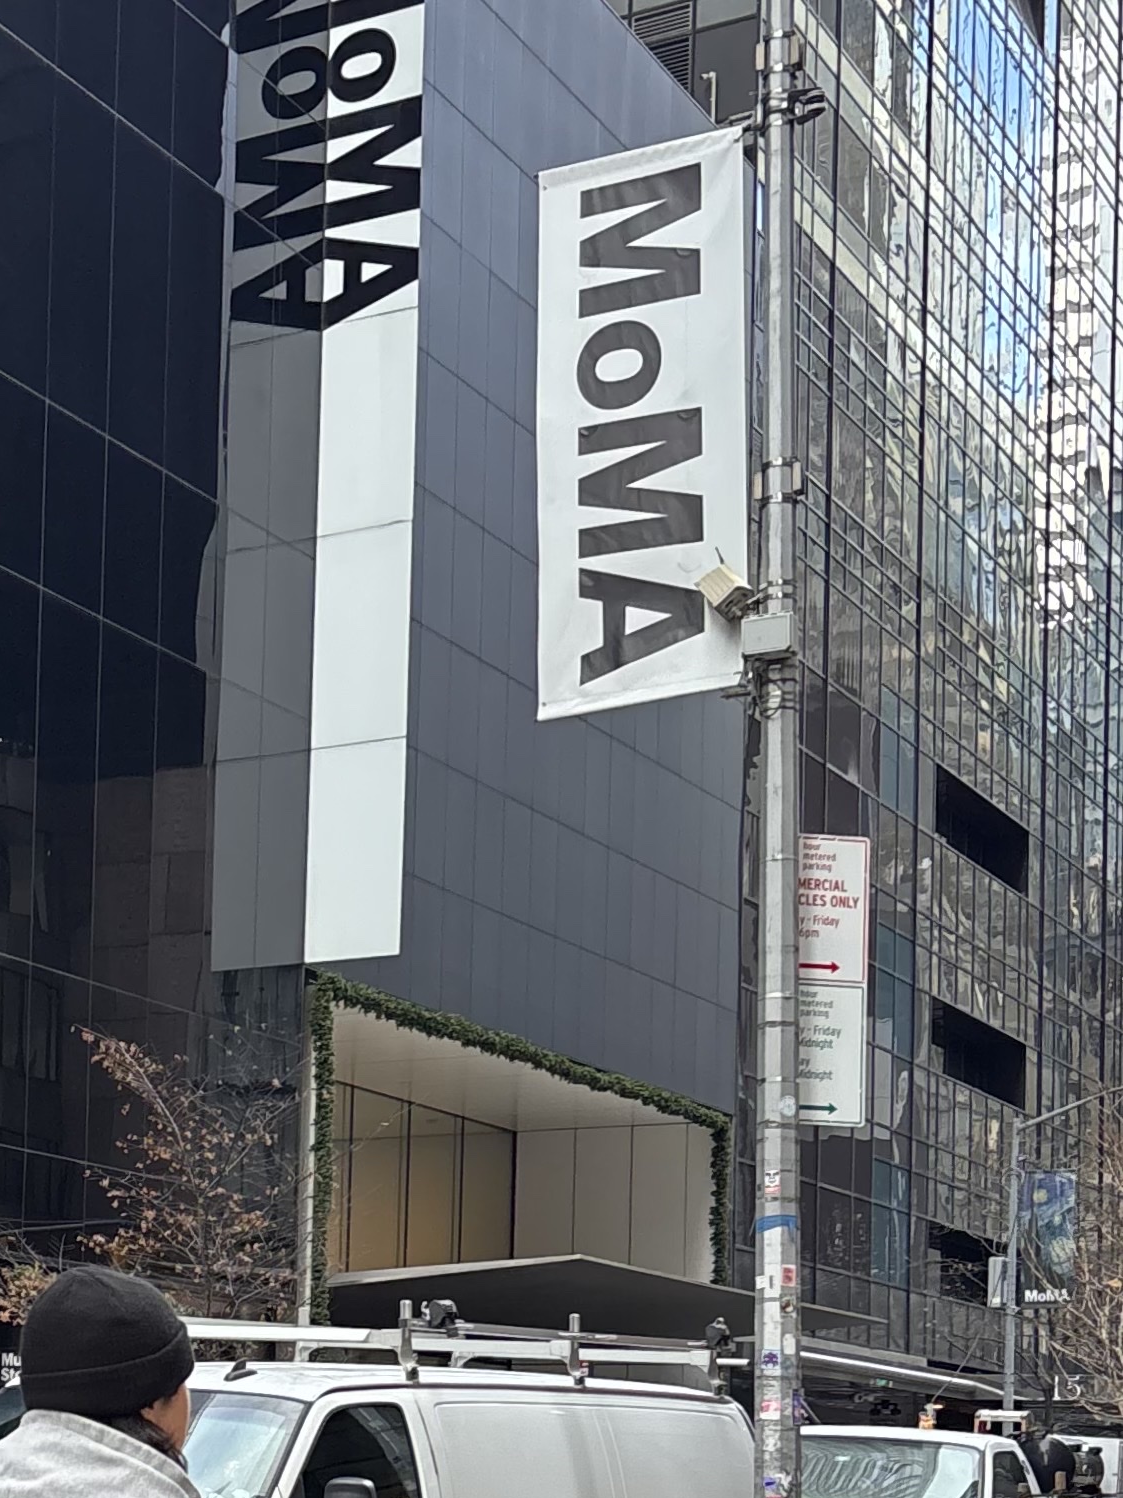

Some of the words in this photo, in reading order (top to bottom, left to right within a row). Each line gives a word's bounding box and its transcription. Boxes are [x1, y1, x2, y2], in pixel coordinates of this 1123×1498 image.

[322, 0, 424, 331] oMA
[576, 161, 706, 688] MoMA
[802, 841, 821, 851] hour
[802, 852, 837, 862] metered
[802, 863, 832, 873] parking
[830, 895, 860, 909] ONLY
[813, 914, 840, 928] Friday
[799, 1009, 830, 1020] parking
[813, 1025, 841, 1039] Friday
